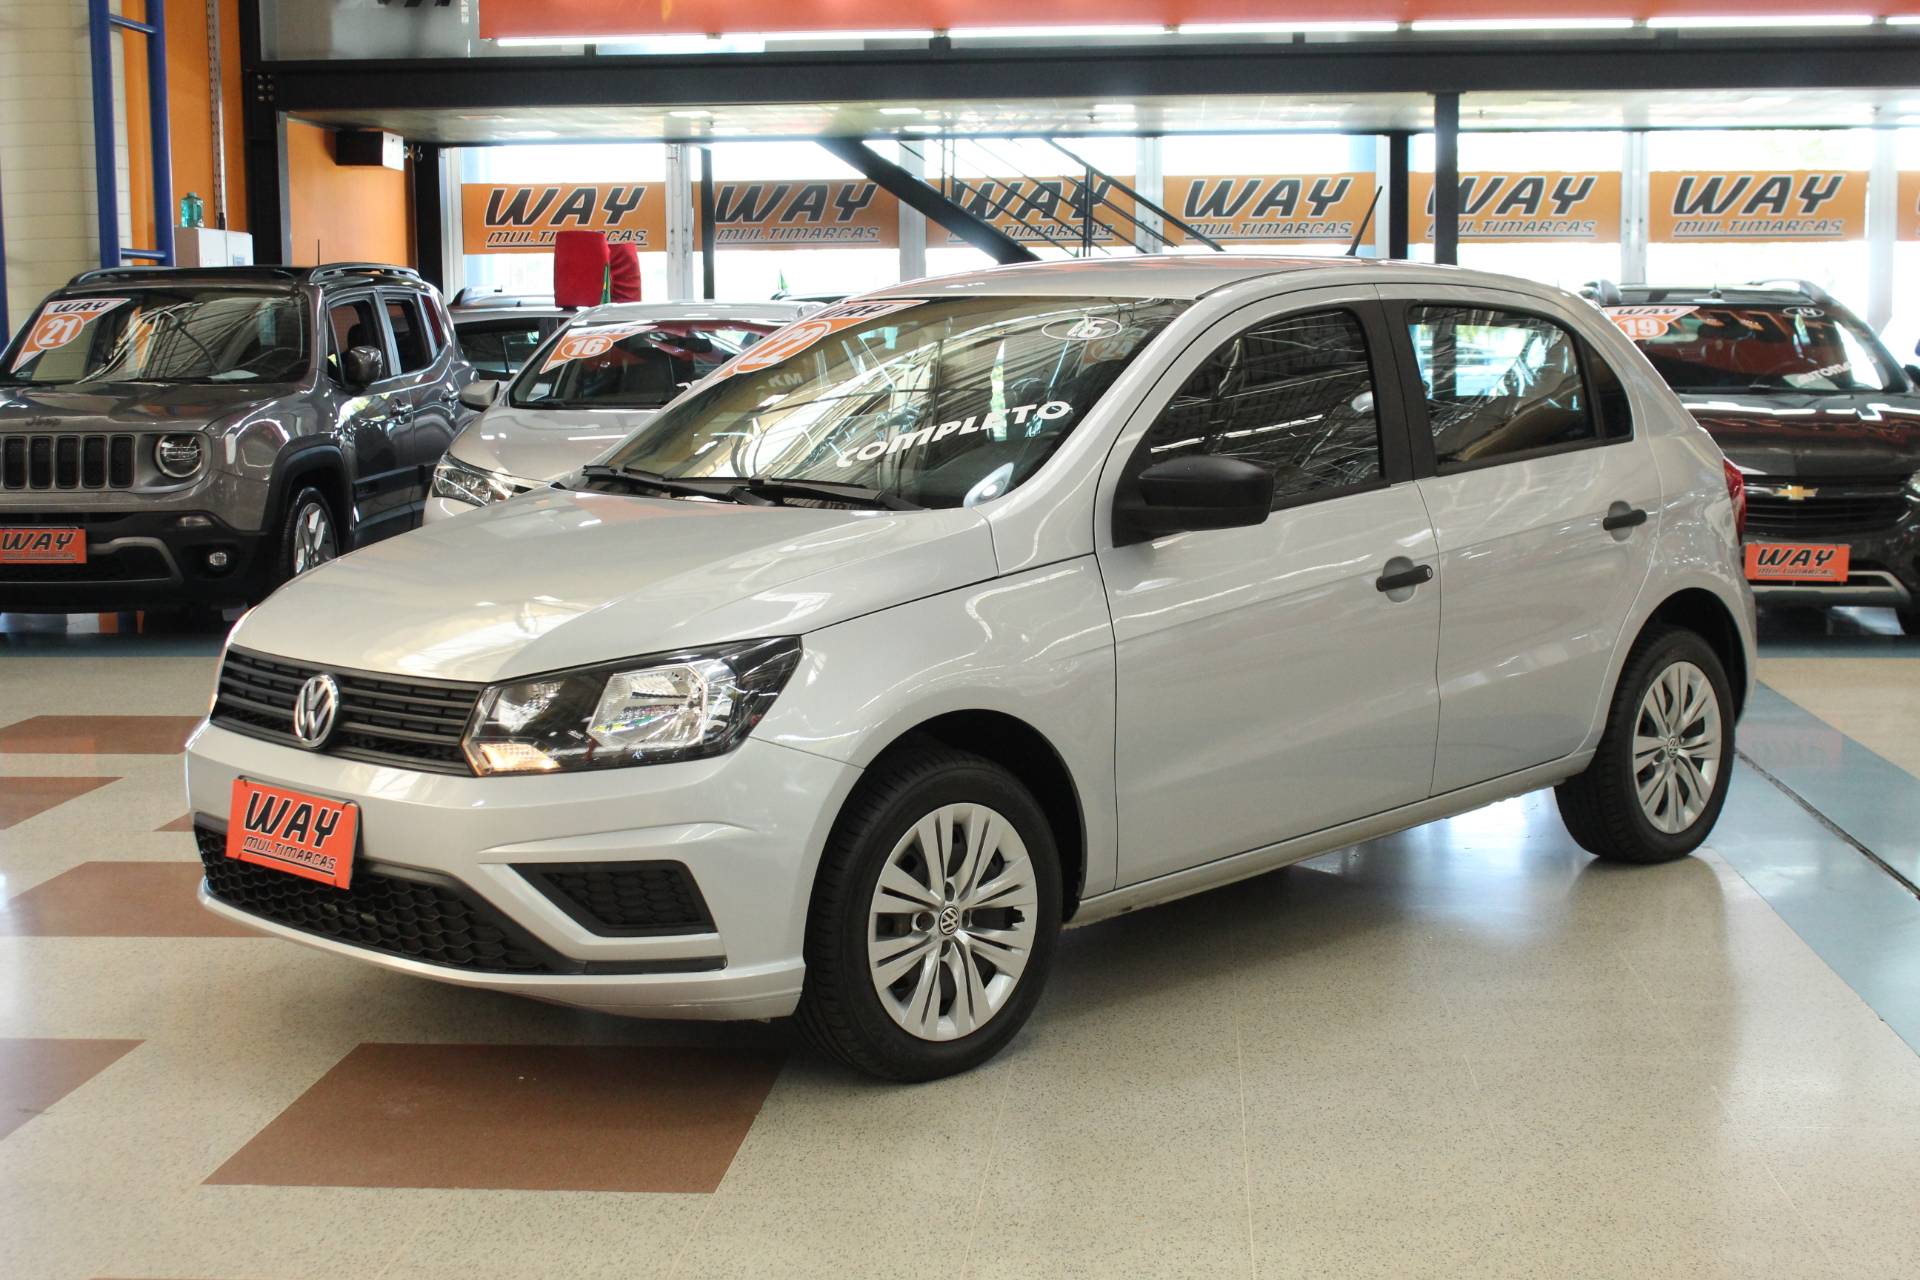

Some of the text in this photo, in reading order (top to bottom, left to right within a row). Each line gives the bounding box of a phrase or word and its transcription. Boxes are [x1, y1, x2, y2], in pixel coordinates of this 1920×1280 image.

[485, 186, 647, 227] WAY
[715, 184, 879, 223] WAY
[955, 180, 1112, 221] WAY
[1184, 177, 1353, 219] WAY
[1425, 175, 1598, 216] WAY
[1672, 174, 1846, 216] WAY
[487, 230, 647, 243] MULTICAS
[717, 227, 880, 240] MULTIMARCAS
[1674, 219, 1844, 232] MULTIMARCAS
[54, 301, 108, 313] WAY
[39, 318, 78, 345] 21
[1625, 320, 1659, 336] 19
[569, 339, 608, 356] 16
[836, 400, 1070, 468] COMPLETO
[2, 533, 75, 551] WAY
[1758, 548, 1835, 567] WAY
[243, 791, 342, 848] WAY
[243, 835, 337, 870] MULTIMARCAS
